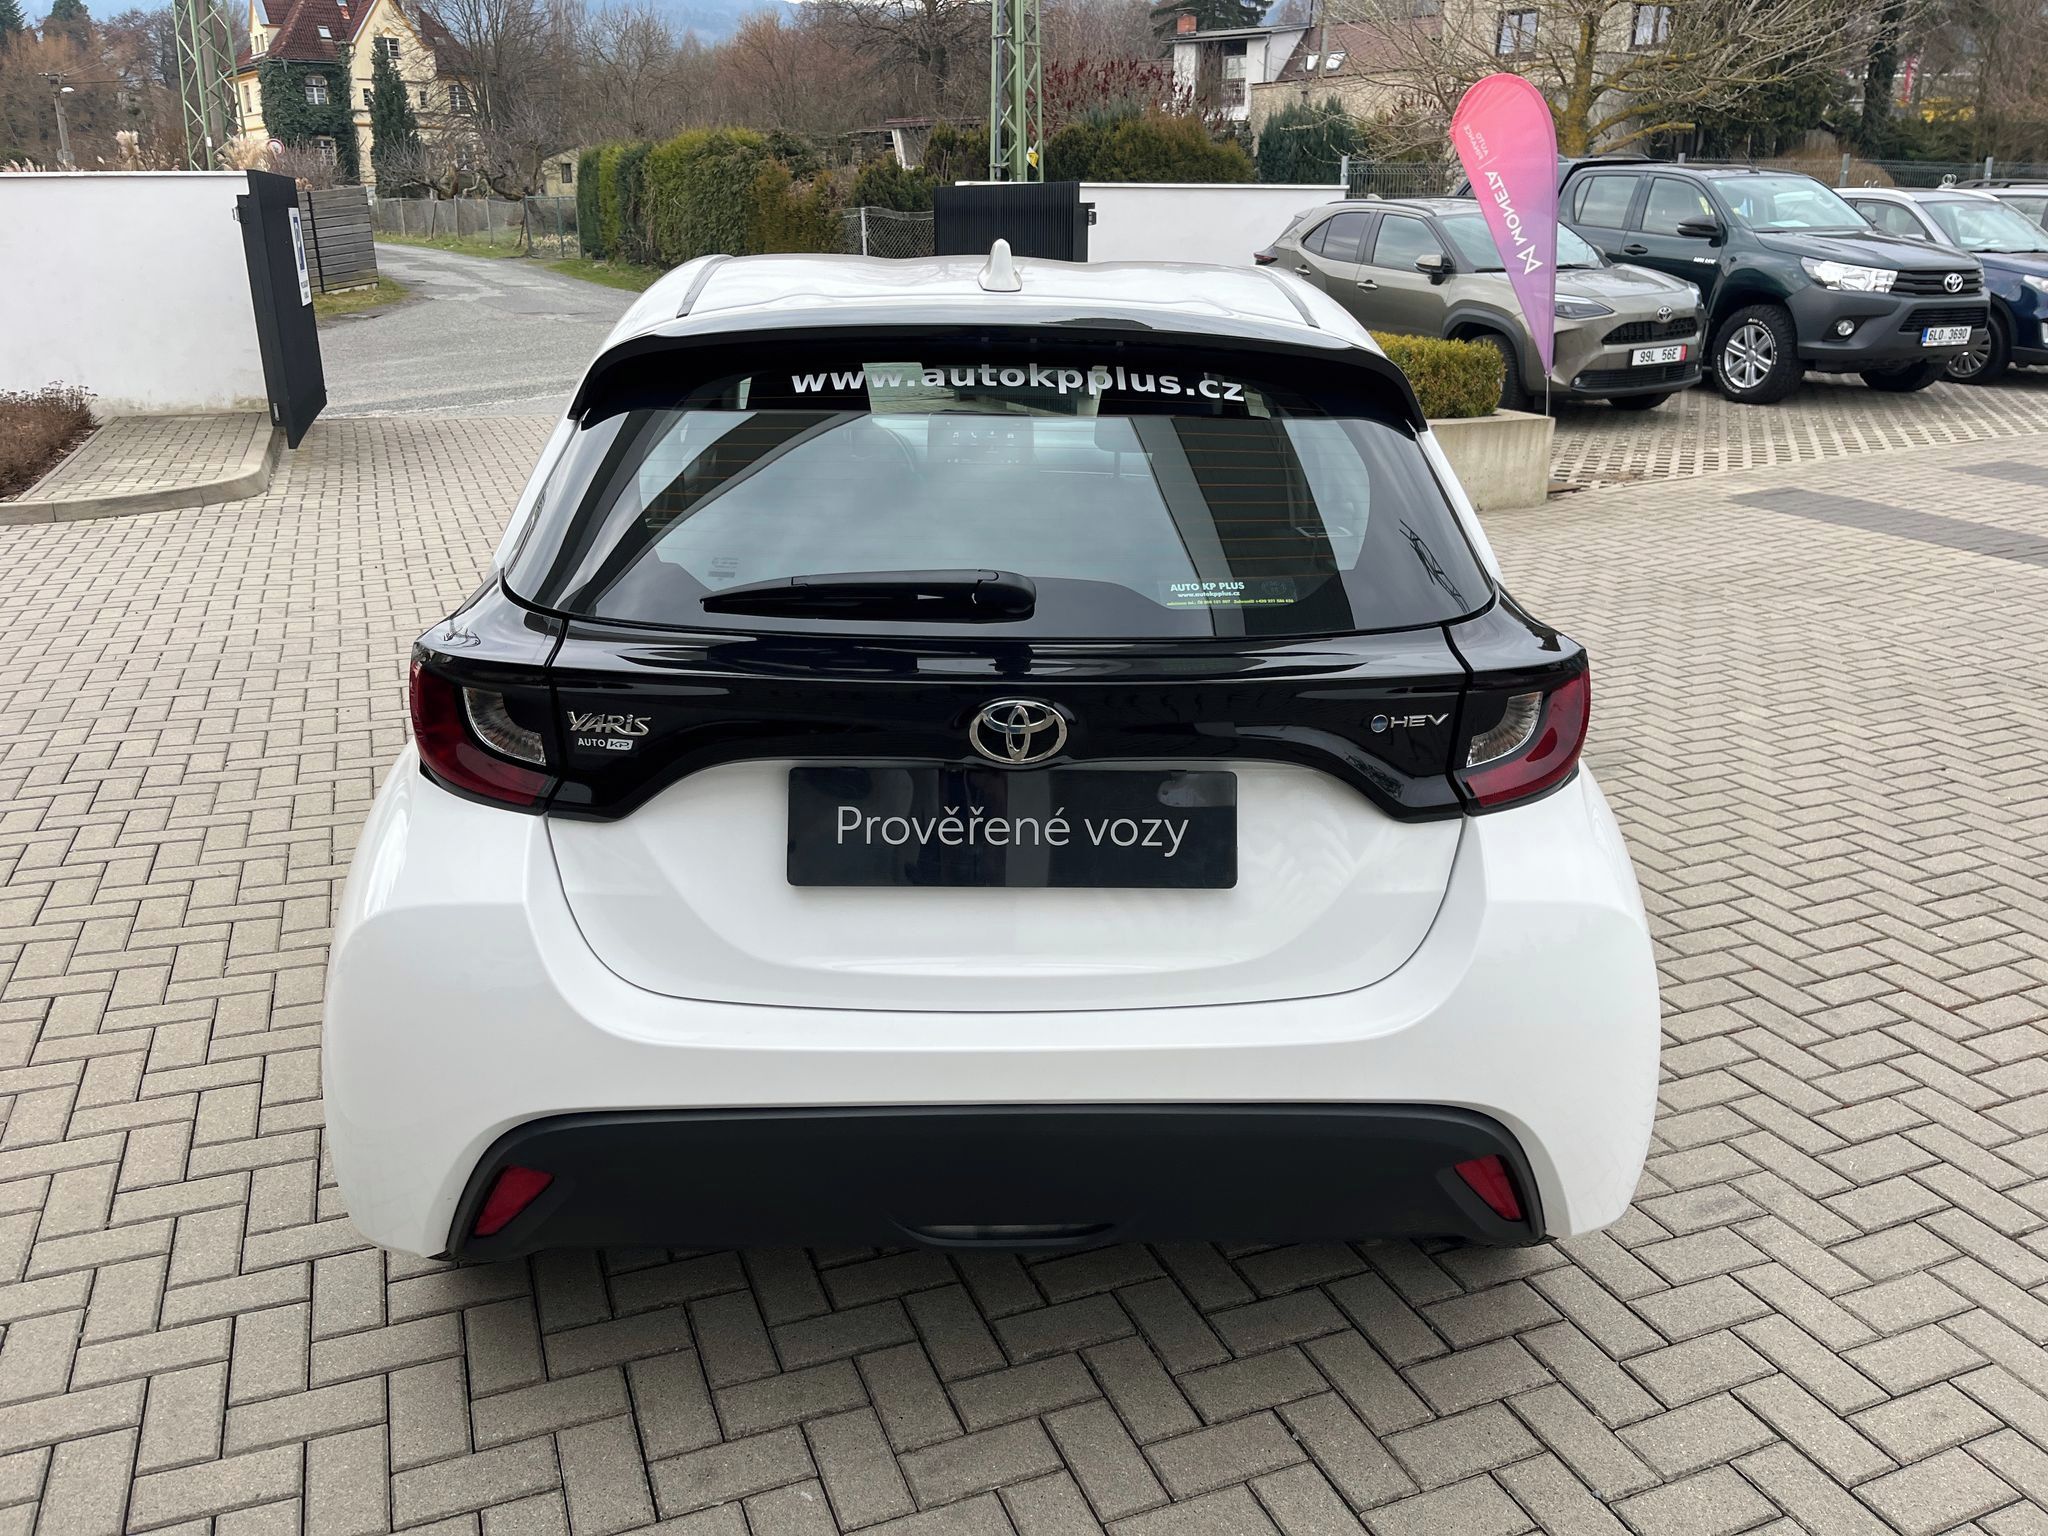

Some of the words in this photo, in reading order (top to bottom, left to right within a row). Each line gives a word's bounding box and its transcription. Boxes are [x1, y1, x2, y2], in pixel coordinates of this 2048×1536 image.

[1640, 350, 1656, 363] 99L
[1662, 347, 1678, 360] 56E
[791, 363, 1245, 402] www.autokpplus.cz
[1170, 583, 1199, 592] AUTO
[1202, 582, 1216, 590] KP
[1219, 581, 1245, 590] PLUS
[578, 737, 606, 748] AUTO
[836, 806, 1071, 847] Prověřené
[1084, 818, 1190, 858] vozy
